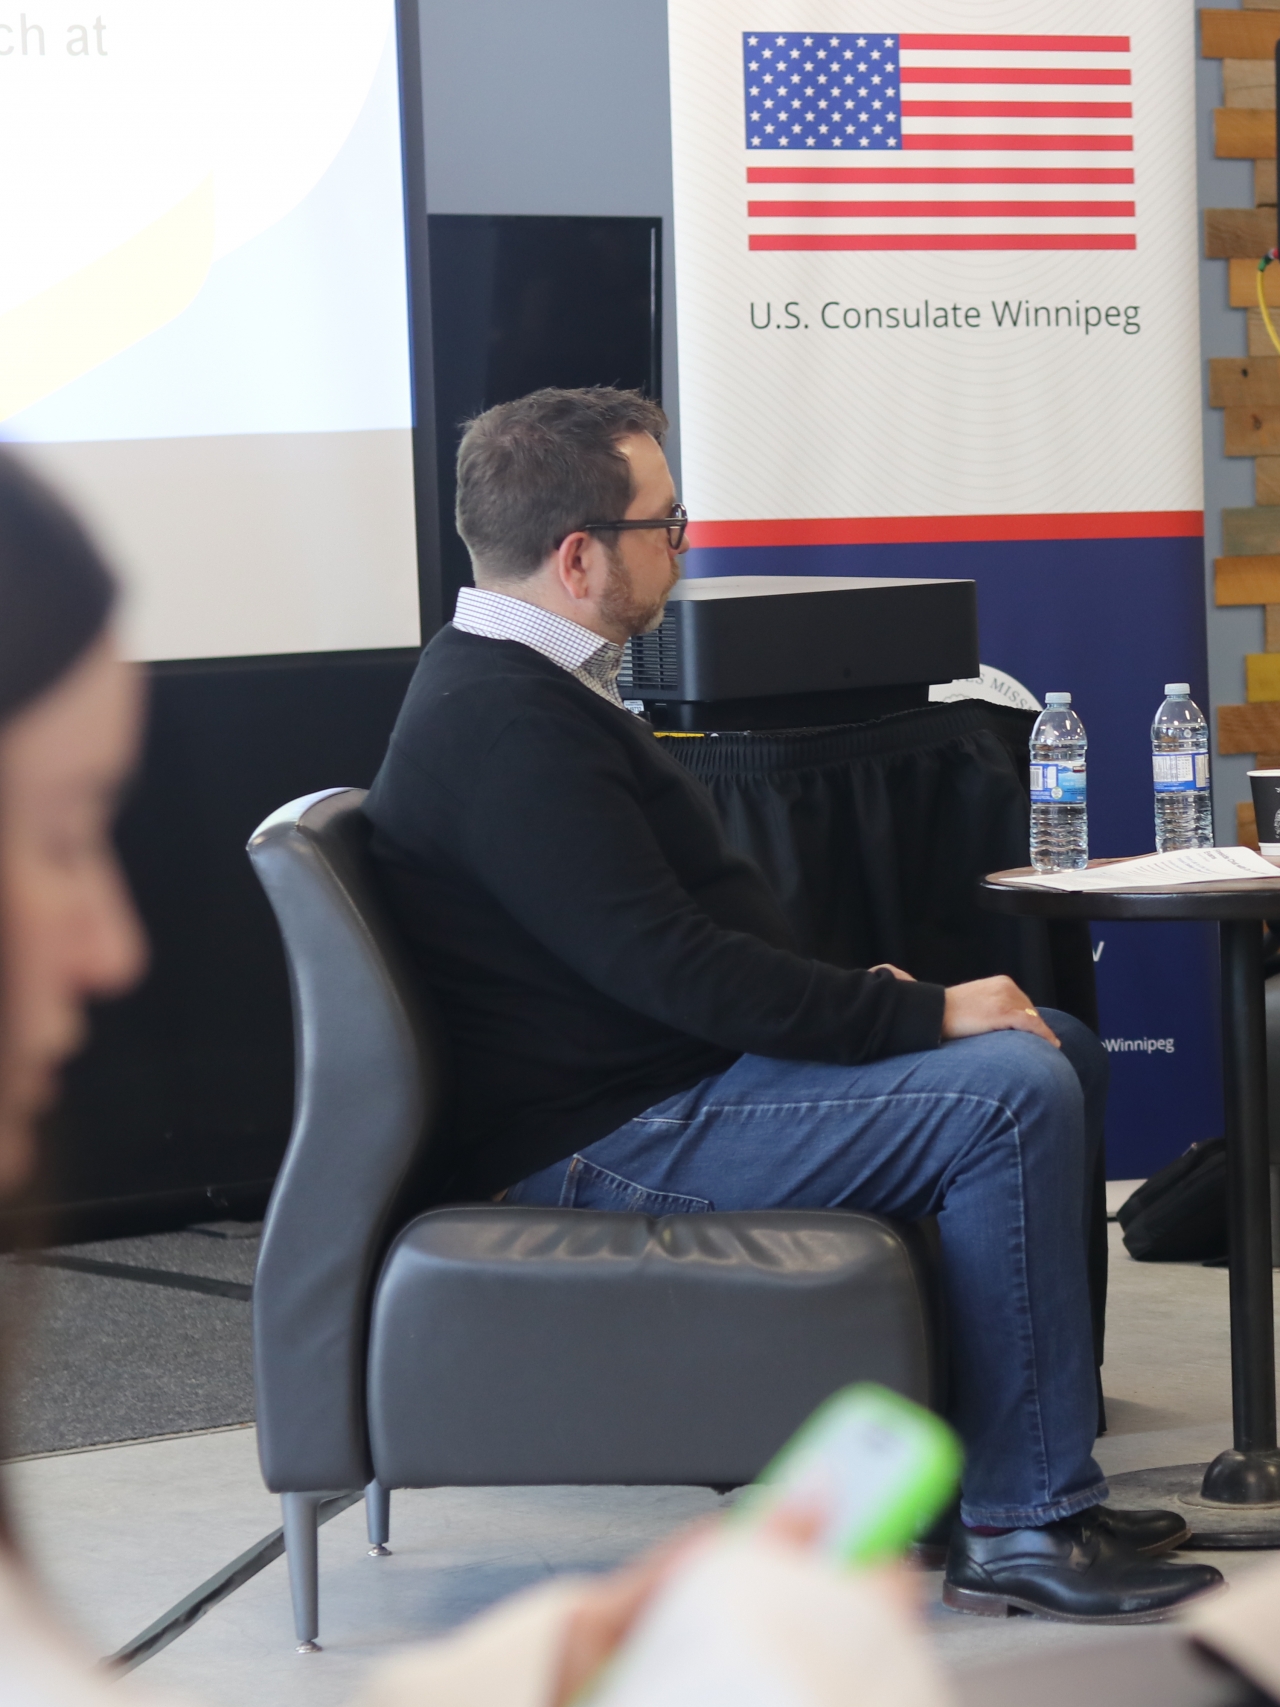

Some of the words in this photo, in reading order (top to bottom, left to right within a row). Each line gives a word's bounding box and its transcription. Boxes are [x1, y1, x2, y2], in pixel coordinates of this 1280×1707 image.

[65, 15, 108, 57] at
[750, 301, 810, 330] U.S.
[820, 300, 981, 330] Consulate
[991, 300, 1141, 336] Winnipeg
[1101, 1036, 1175, 1054] Winnipeg
